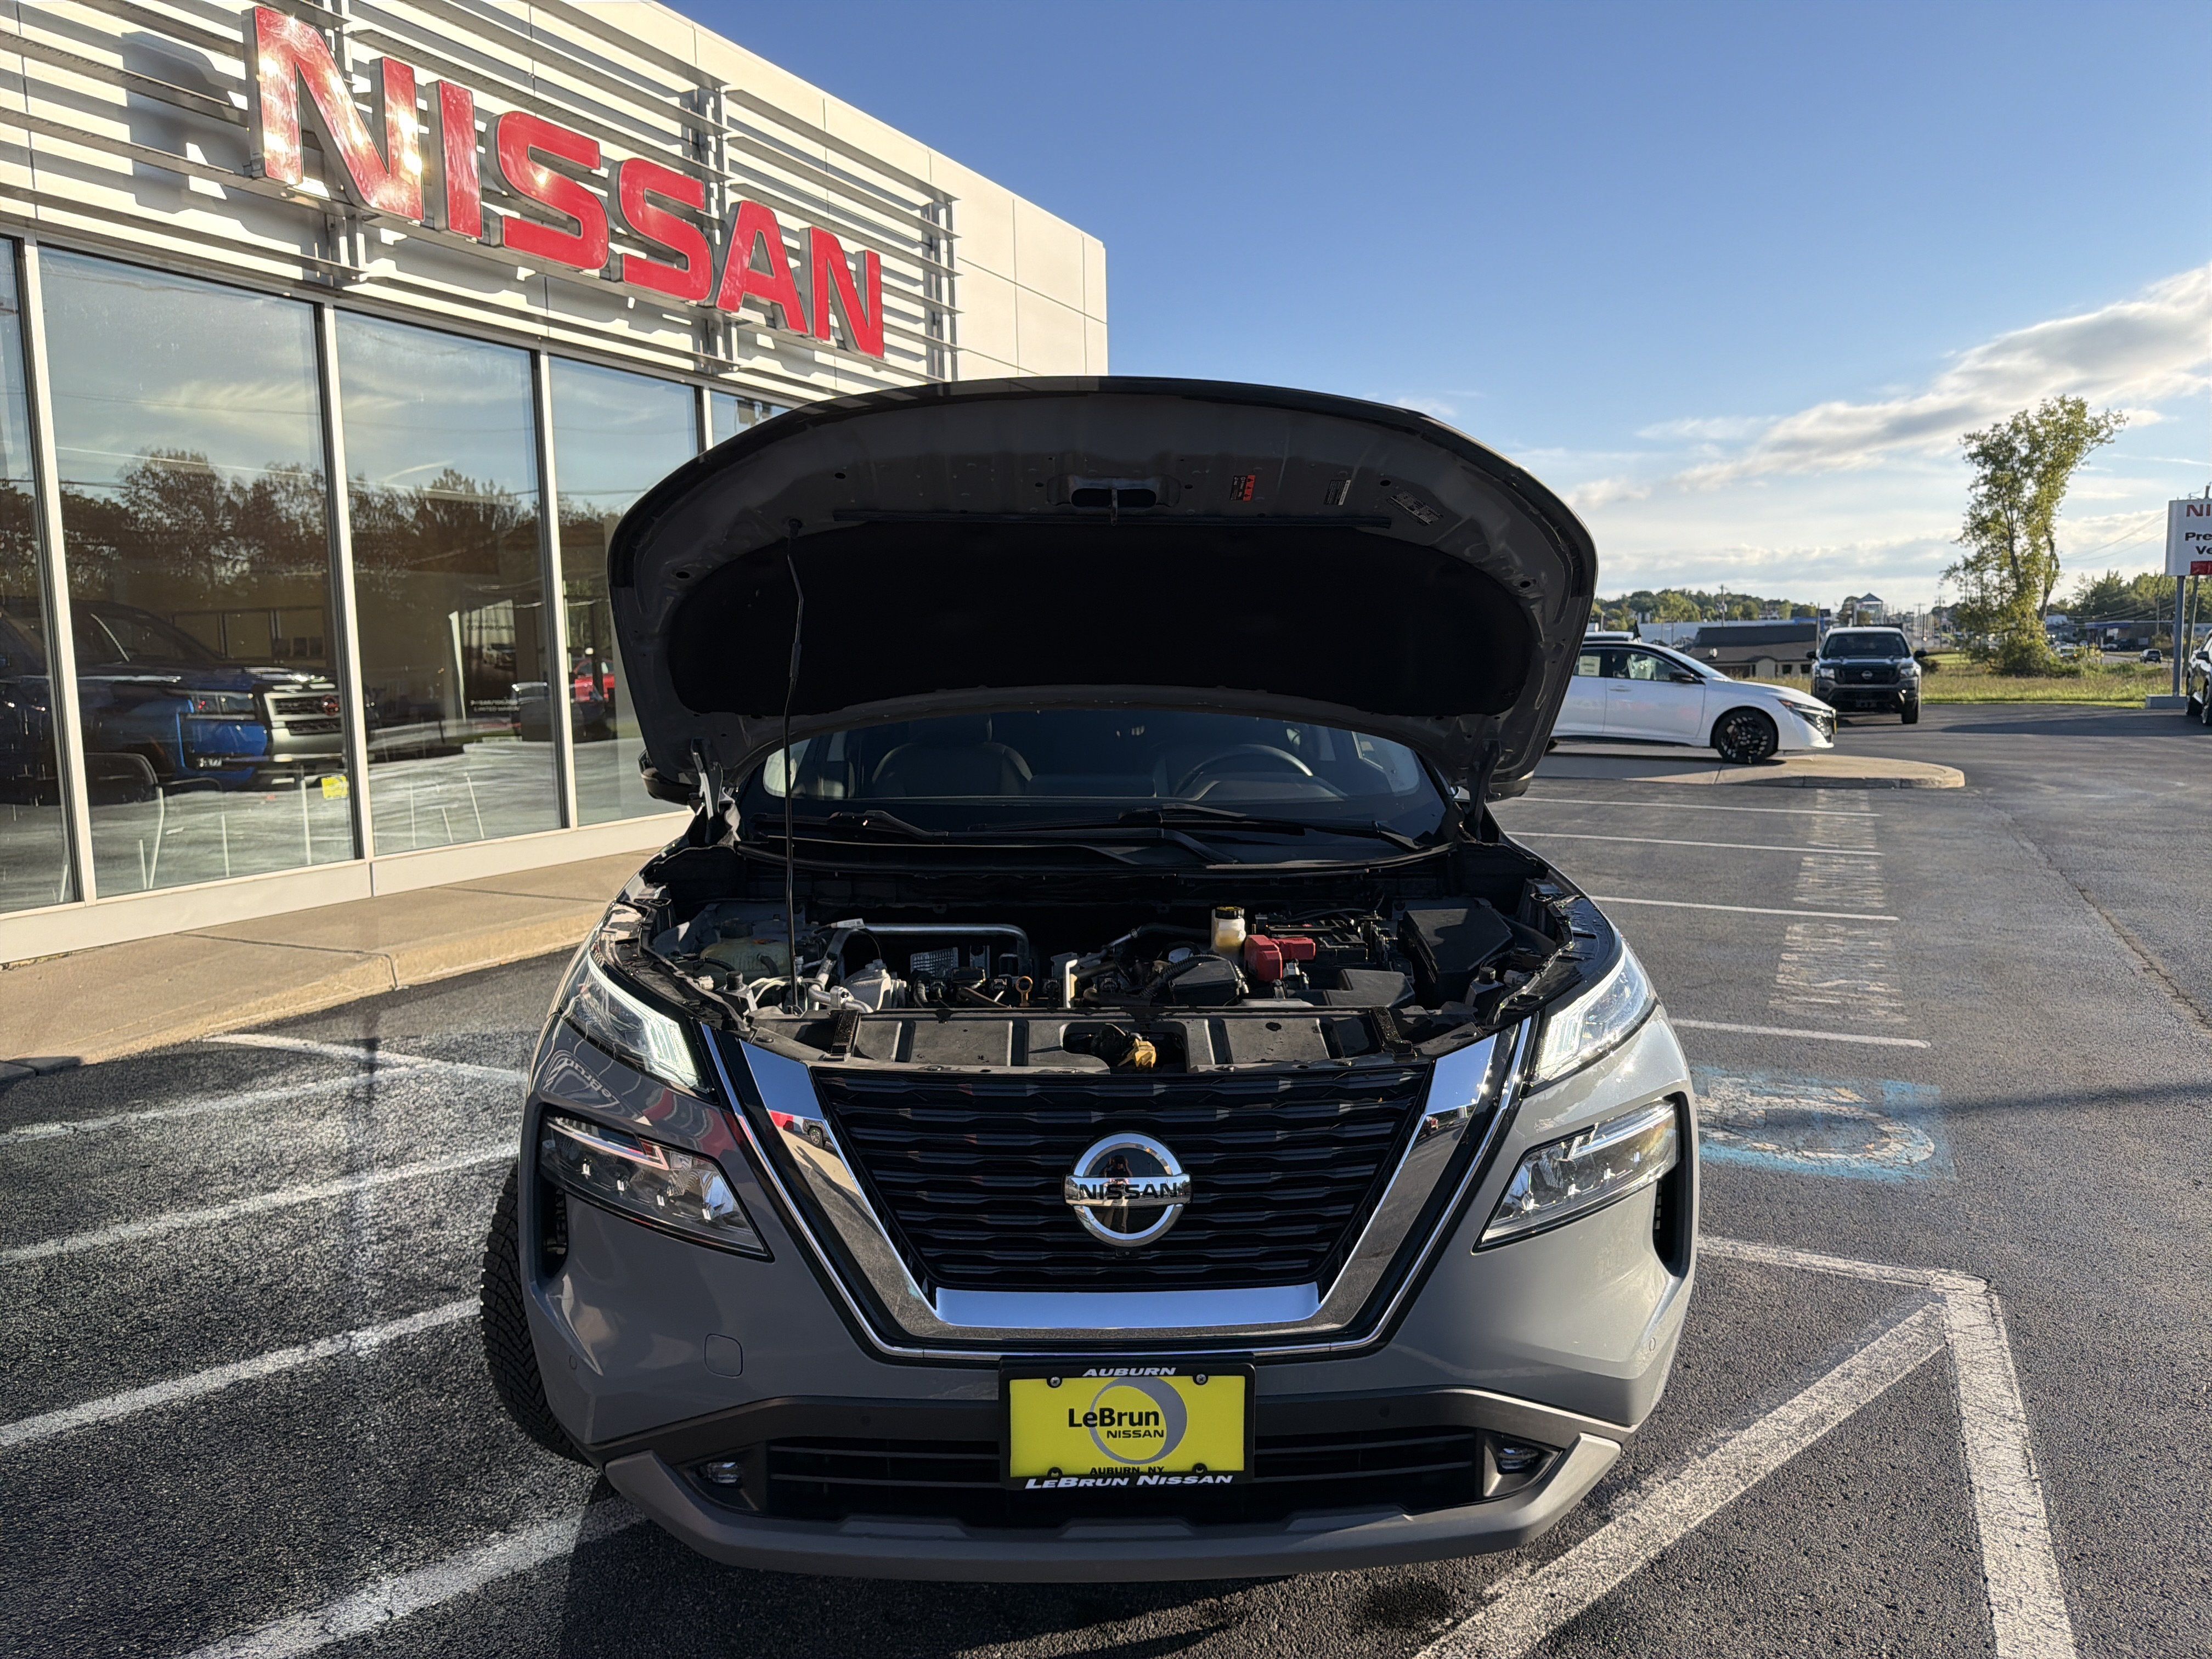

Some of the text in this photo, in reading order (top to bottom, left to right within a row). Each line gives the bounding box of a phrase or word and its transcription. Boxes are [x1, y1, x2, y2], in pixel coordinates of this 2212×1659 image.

[245, 5, 885, 359] NISSAN
[1079, 1182, 1177, 1200] NISSAN
[1082, 1367, 1176, 1377] AUBURN
[1068, 1408, 1159, 1427] LeBrun
[1107, 1429, 1164, 1438] NISSAN
[1136, 1475, 1233, 1486] NISSAN
